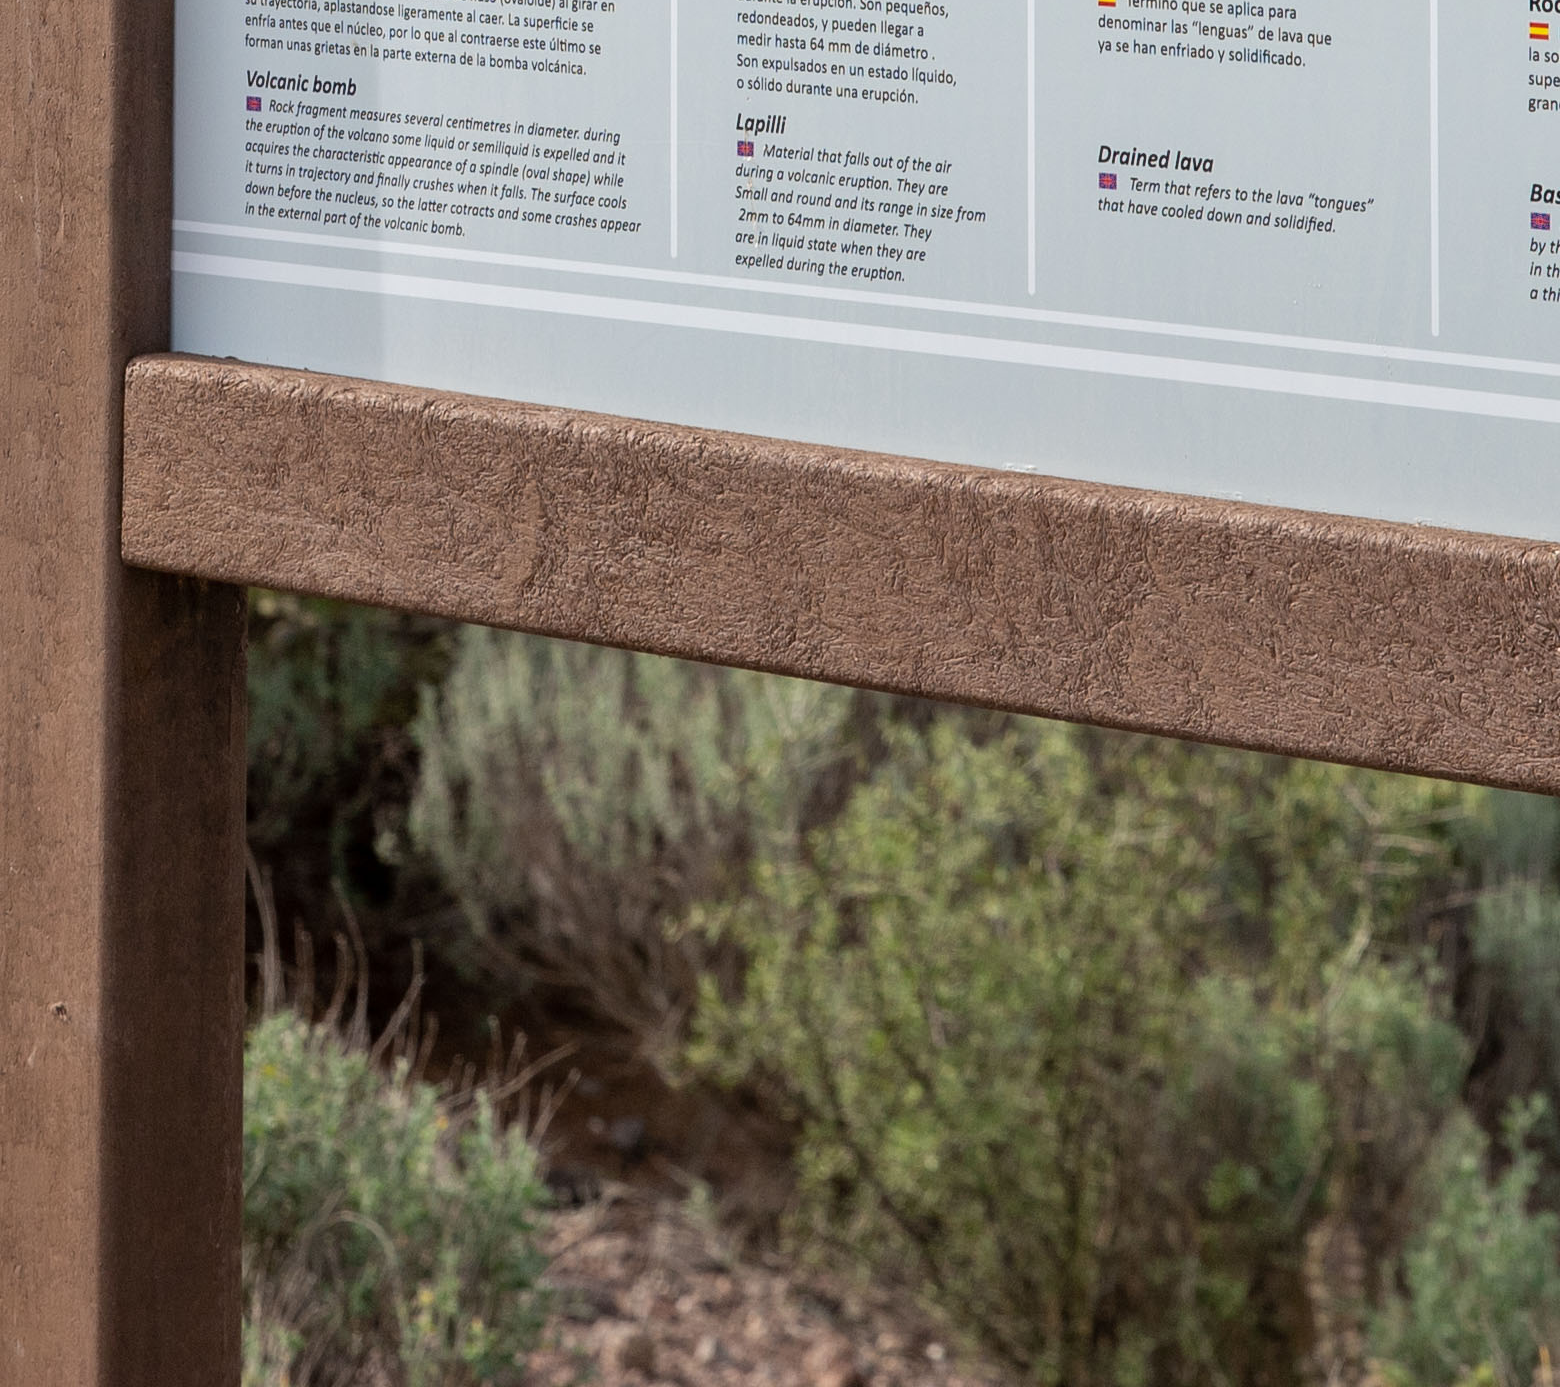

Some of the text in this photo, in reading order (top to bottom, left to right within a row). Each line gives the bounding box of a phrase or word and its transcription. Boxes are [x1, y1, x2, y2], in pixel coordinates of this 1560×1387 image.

[1182, 1, 1205, 14] que
[1210, 3, 1223, 14] se
[1227, 1, 1264, 18] aplica
[1269, 7, 1296, 21] para
[1098, 14, 1167, 32] denominar
[1171, 19, 1188, 34] las
[1258, 26, 1274, 41] de
[1278, 27, 1303, 43] lava
[1307, 33, 1332, 47] que
[247, 70, 356, 96] Volcanic bomb
[269, 99, 620, 146] Rock fragment measures several centimetres in diameter. during
[736, 113, 786, 135] Lapilli
[763, 144, 952, 173] Material that falls out of the air
[1098, 145, 1213, 173] Drained lava
[1130, 177, 1160, 193] Term
[1165, 180, 1191, 196] that
[1194, 183, 1231, 201] refers
[1235, 188, 1248, 201] to
[1252, 188, 1273, 203] the
[1276, 190, 1304, 206] lava
